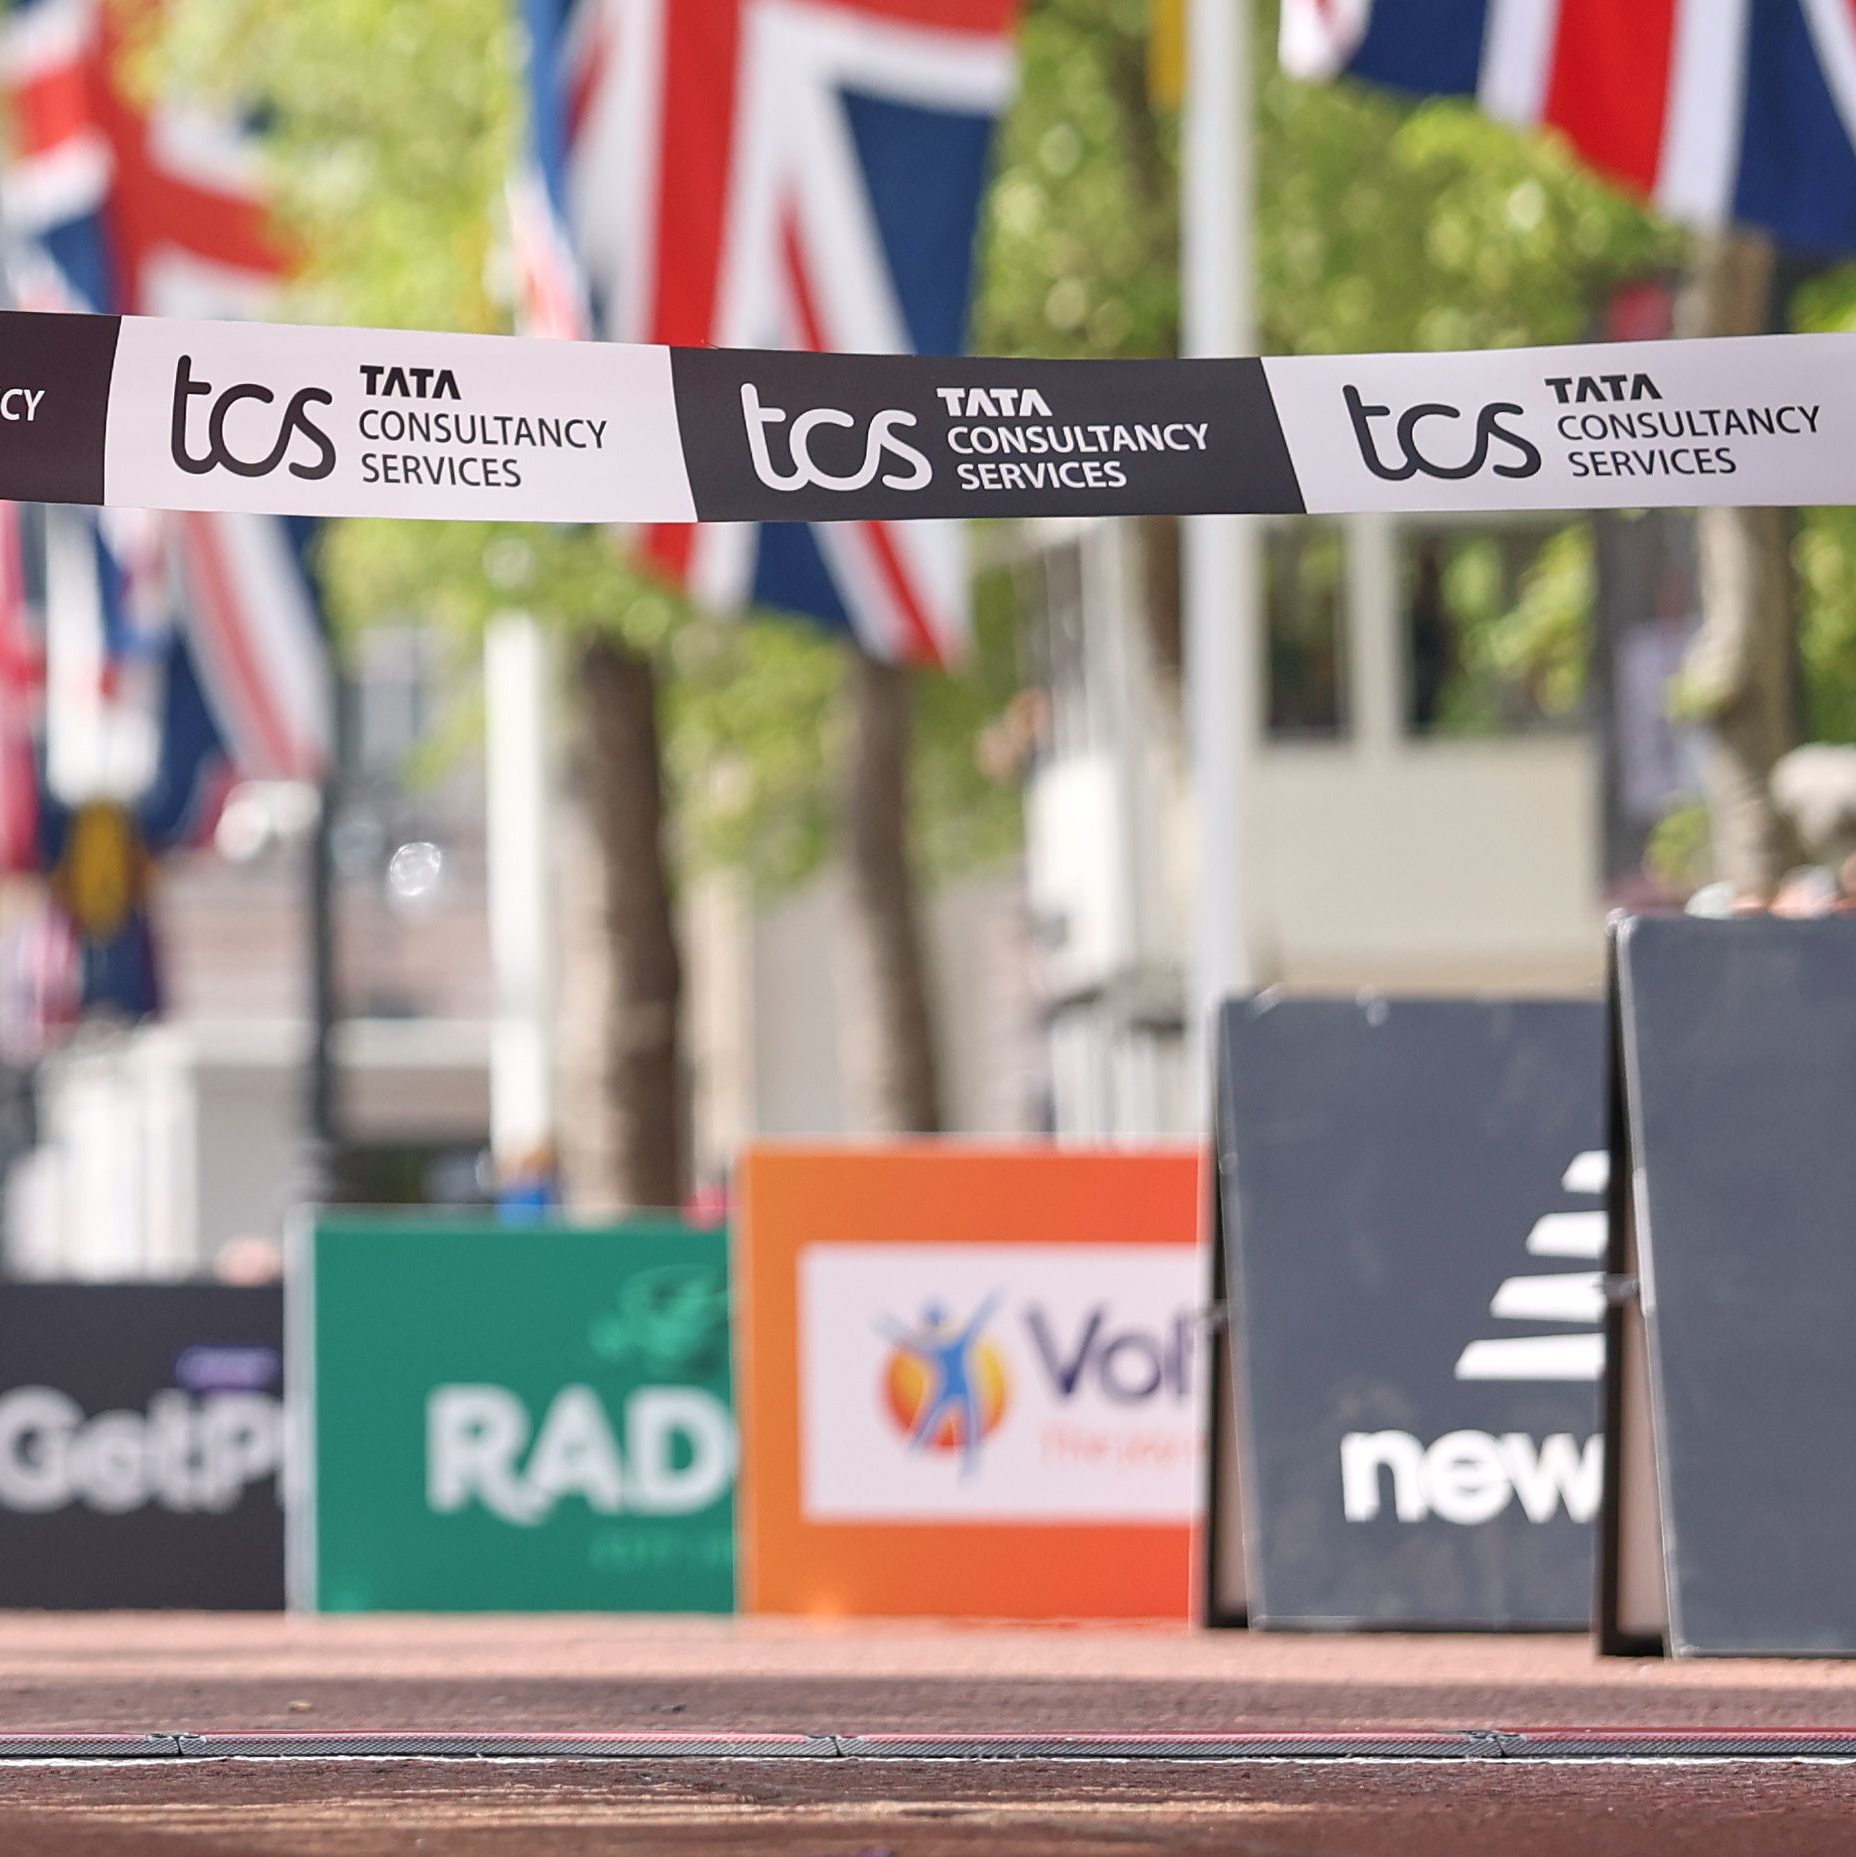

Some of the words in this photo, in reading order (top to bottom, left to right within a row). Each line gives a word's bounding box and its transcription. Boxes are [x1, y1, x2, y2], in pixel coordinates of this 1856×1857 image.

[359, 364, 461, 400] TATA
[1545, 373, 1662, 404] TATA
[171, 354, 336, 480] tcs
[937, 388, 1052, 417] TATA
[358, 409, 607, 450] CONSULTANCY
[740, 383, 933, 492] tcs
[946, 423, 1208, 456] CONSULTANCY
[1343, 384, 1542, 482] tcs
[1557, 405, 1820, 442] CONSULTANCY
[362, 454, 521, 489] SERVICES
[956, 461, 1127, 491] SERVICES
[1567, 446, 1737, 478] SERVICES
[1341, 1429, 1604, 1524] new
